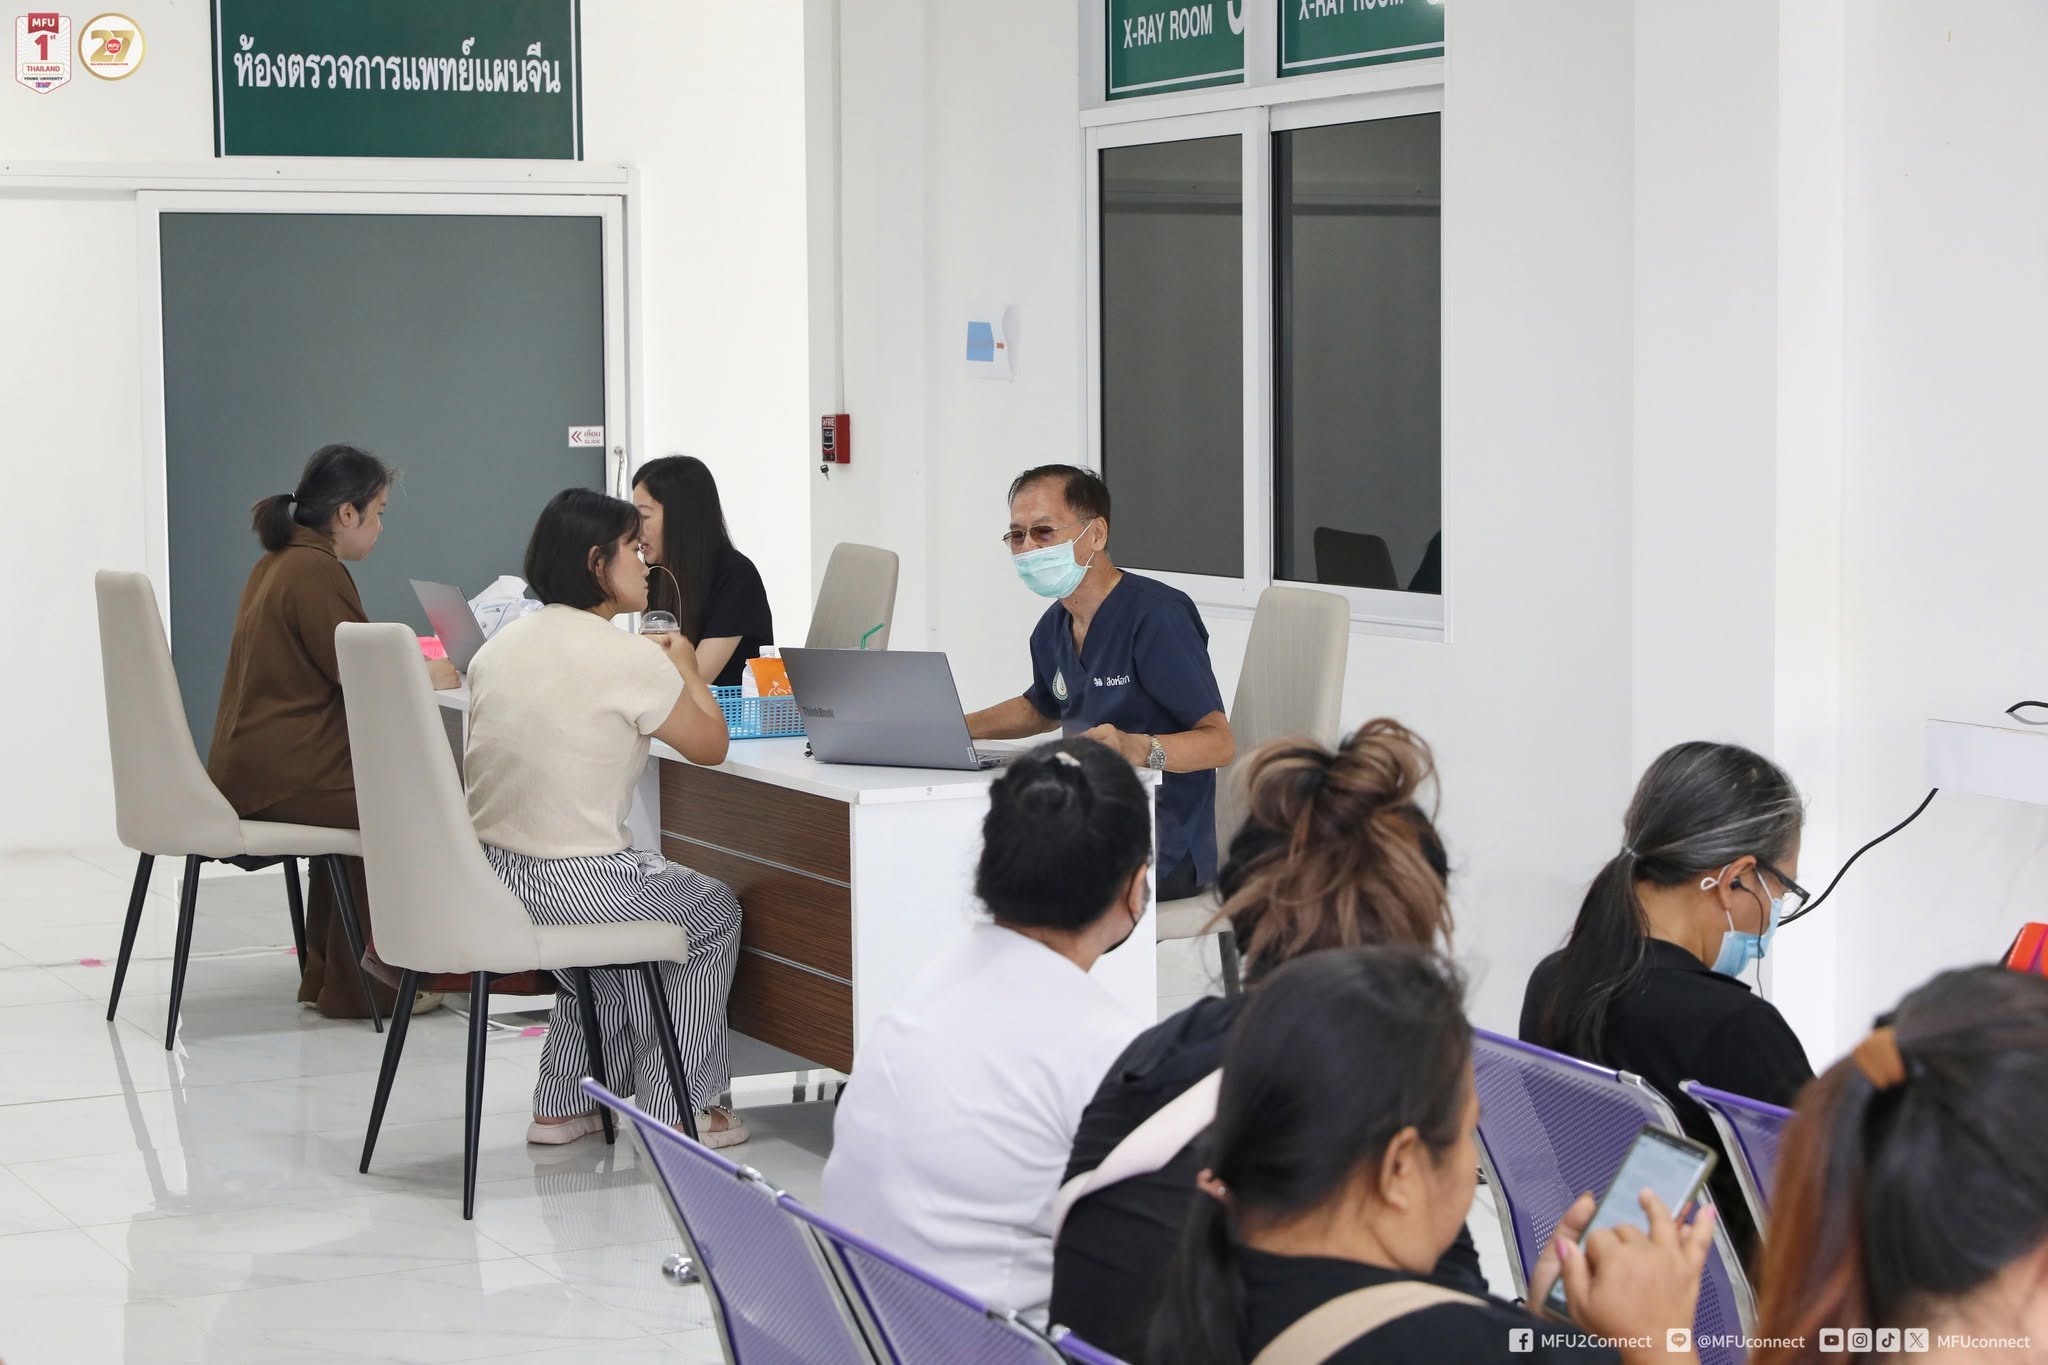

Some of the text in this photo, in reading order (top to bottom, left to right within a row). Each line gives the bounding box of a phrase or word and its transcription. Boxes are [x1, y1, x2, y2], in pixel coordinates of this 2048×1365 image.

[1123, 12, 1166, 49] X-RAY
[1170, 3, 1213, 41] ROOM
[233, 34, 562, 94] ห้องตรวจการแพทย์แผนจีน
[802, 706, 835, 719] ThinkBook
